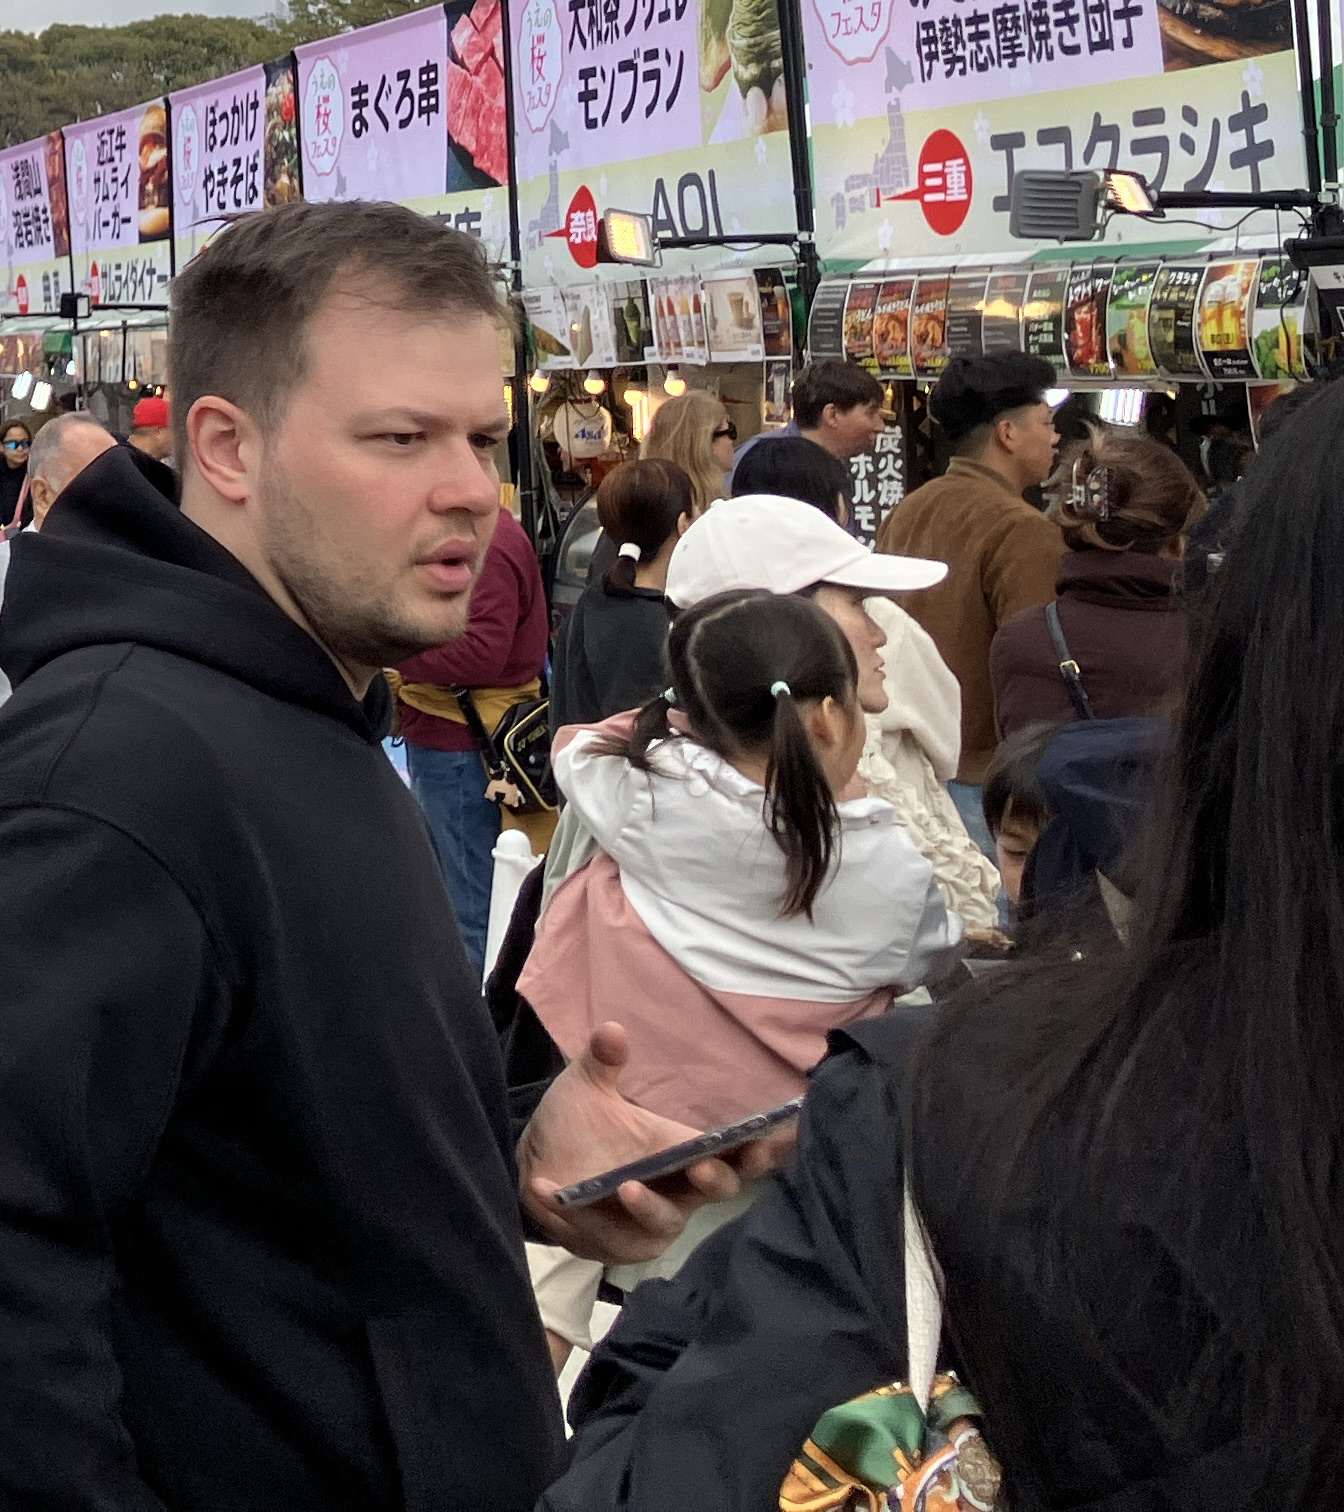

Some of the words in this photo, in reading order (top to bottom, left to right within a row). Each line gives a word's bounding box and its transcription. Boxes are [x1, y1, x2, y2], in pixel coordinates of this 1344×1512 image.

[525, 2, 553, 36] うえの
[829, 0, 883, 40] フェスタ
[528, 34, 549, 85] 桜
[312, 70, 336, 95] うえの
[350, 59, 441, 139] まぐろ串
[523, 85, 552, 113] フェスタ
[578, 46, 685, 131] モンブラン
[204, 89, 260, 153] ぼっかけ
[313, 96, 333, 140] 桜
[96, 125, 127, 167] 近江牛
[309, 138, 339, 163] フェスタ
[93, 163, 132, 204] サムライ
[202, 148, 261, 213] やきそば
[923, 158, 967, 203] 三重
[92, 204, 132, 241] バーガー
[101, 257, 168, 305] サムライダイナー
[875, 425, 904, 520] 炭火焼
